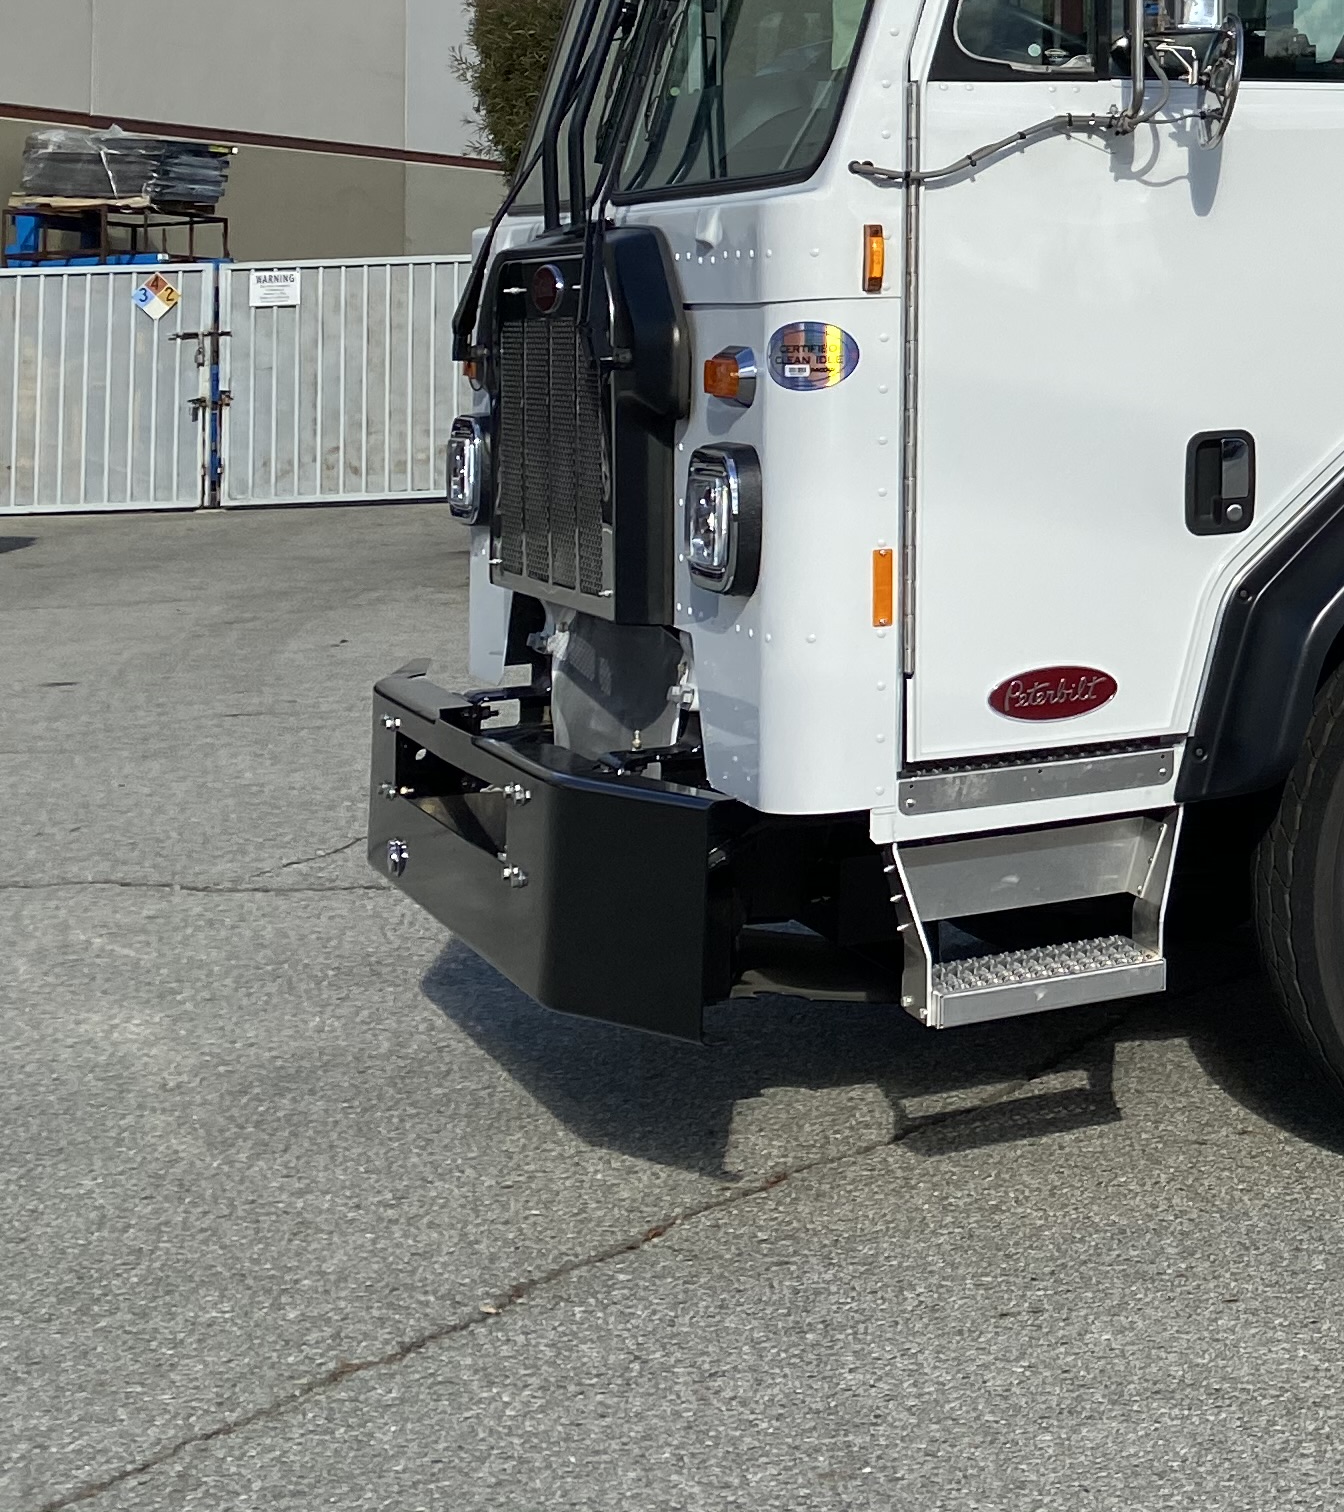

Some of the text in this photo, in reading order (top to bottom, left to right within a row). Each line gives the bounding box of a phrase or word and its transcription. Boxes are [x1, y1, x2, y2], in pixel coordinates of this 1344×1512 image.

[151, 276, 159, 289] 4
[255, 273, 295, 285] WARNING
[138, 286, 175, 303] 3 2
[775, 354, 844, 365] CLEAN IDLE
[1003, 675, 1107, 712] Peterbilt
